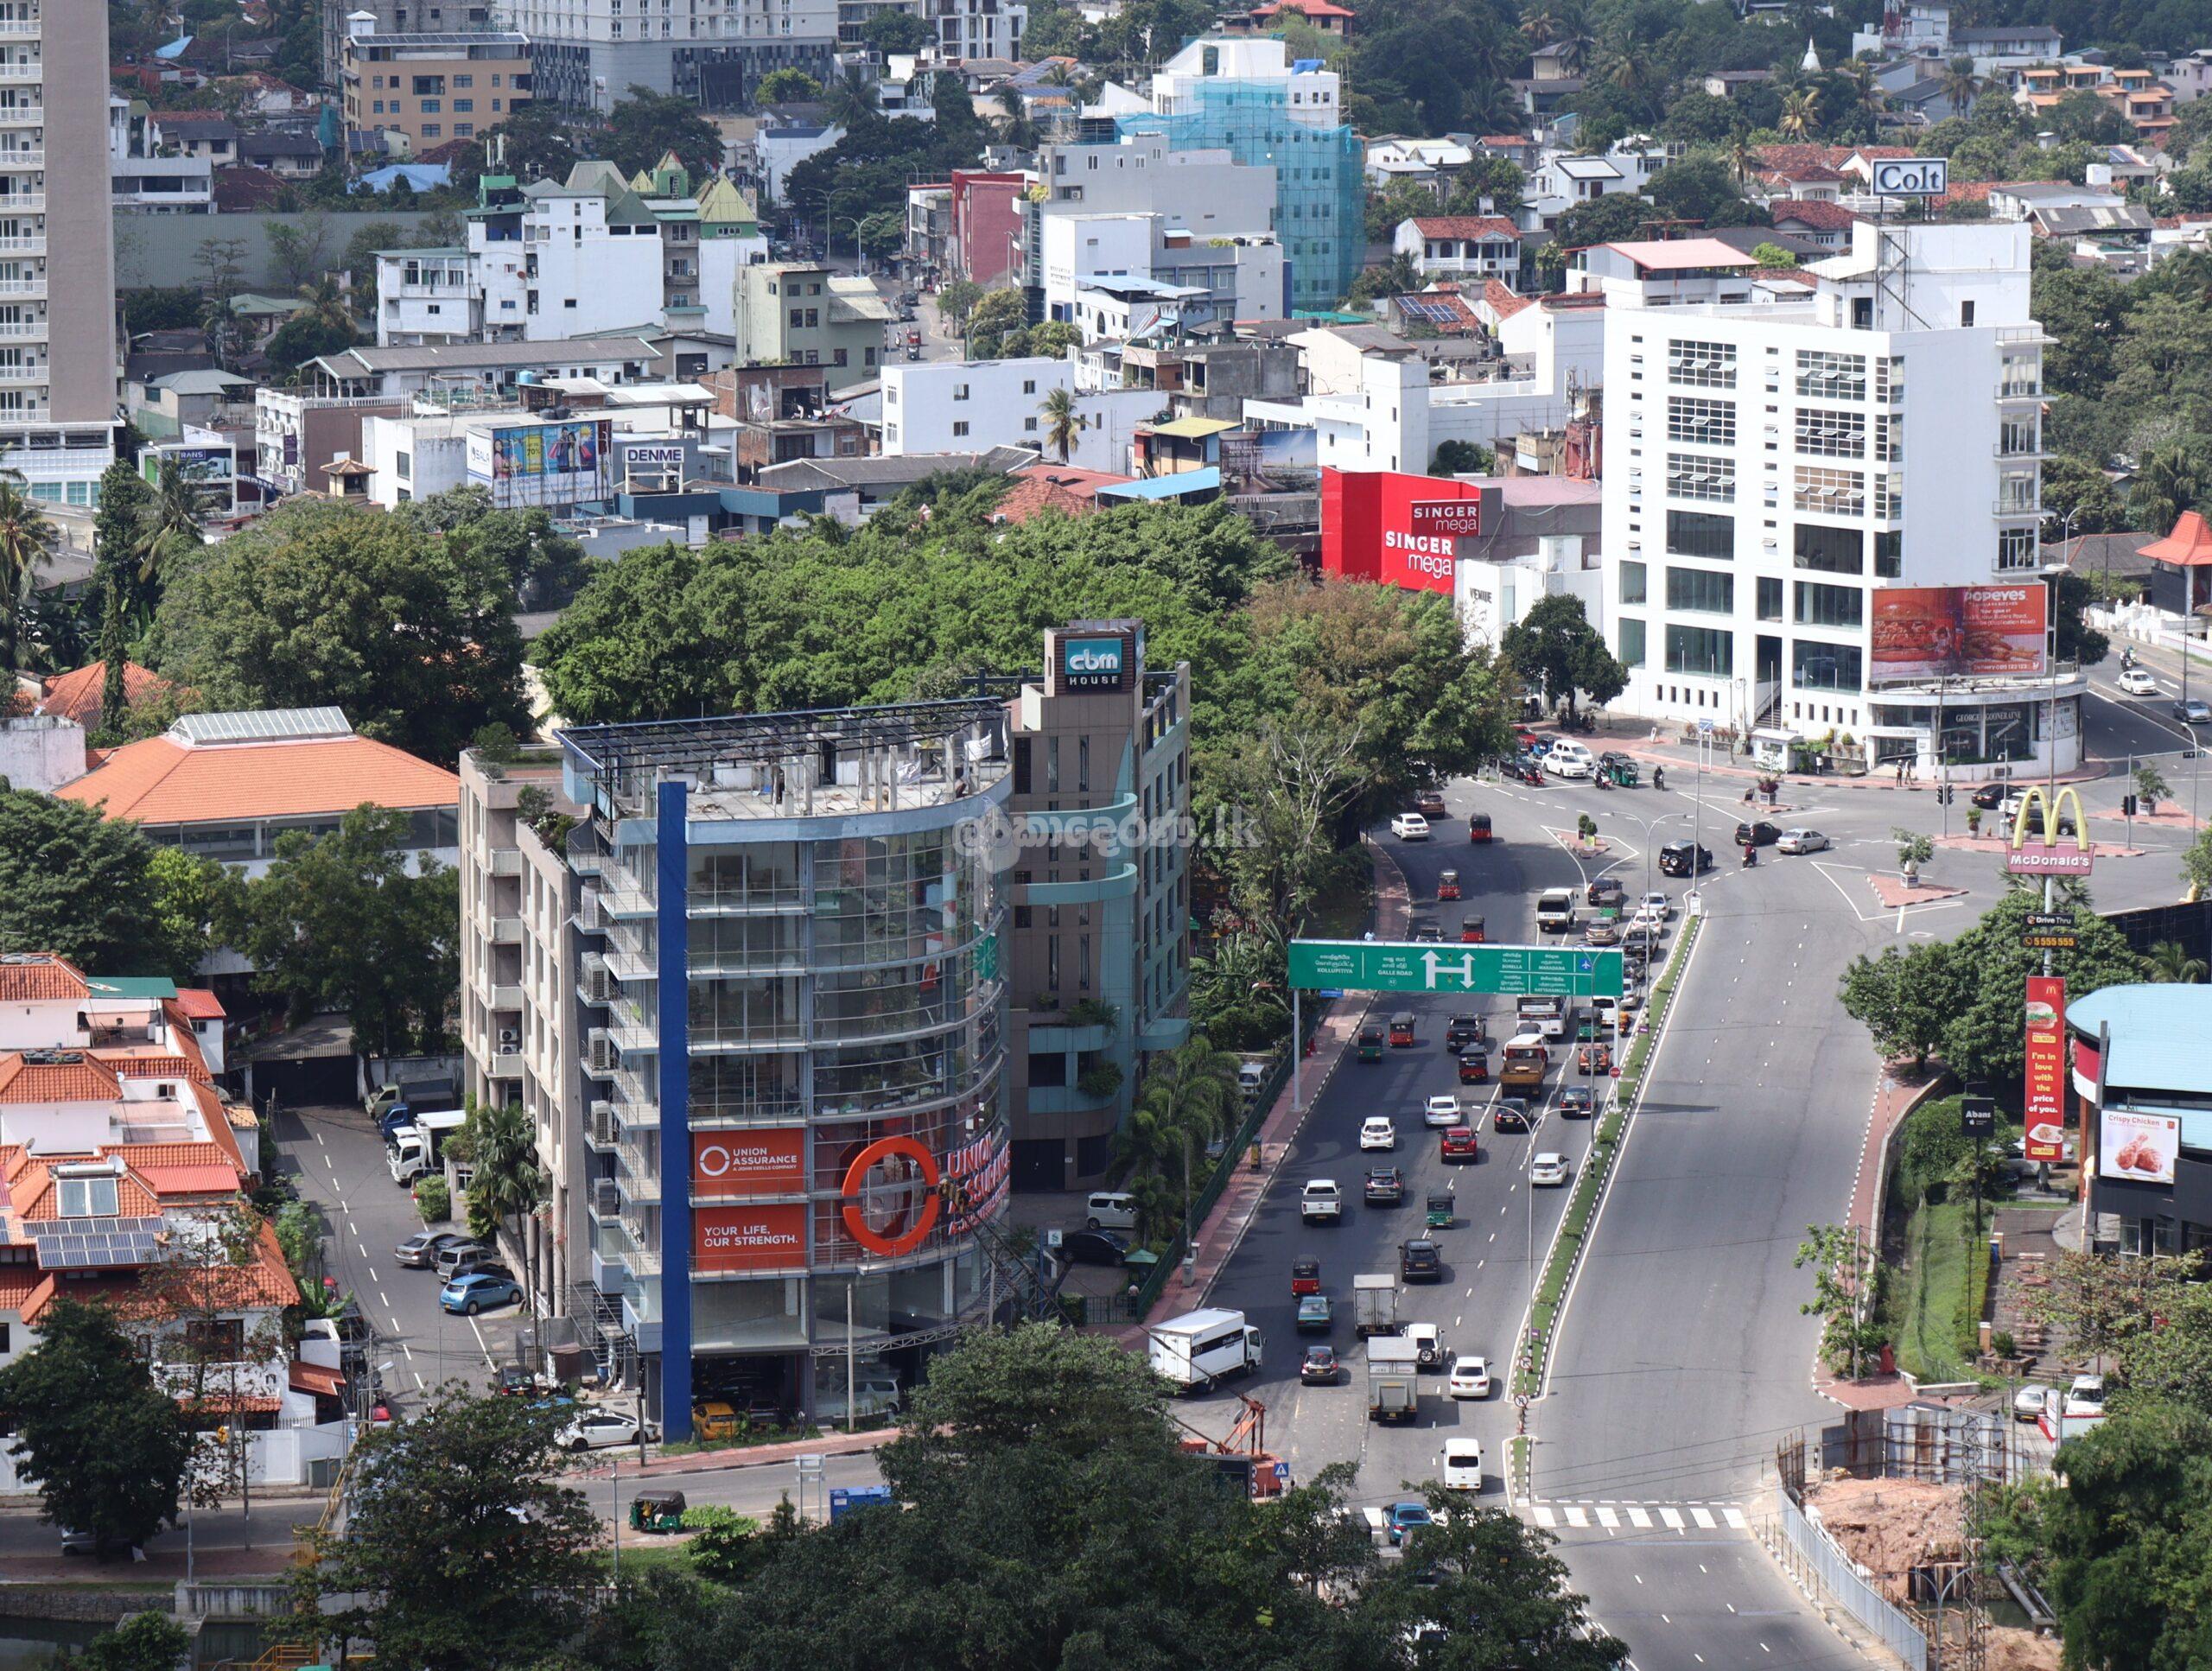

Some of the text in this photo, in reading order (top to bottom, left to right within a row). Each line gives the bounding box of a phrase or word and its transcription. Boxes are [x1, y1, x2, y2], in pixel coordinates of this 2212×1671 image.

[1879, 165, 1939, 190] Colt
[627, 449, 682, 461] DENME
[1414, 506, 1477, 518] SINGER
[1435, 518, 1477, 533] mega
[1385, 531, 1452, 556] SINGER
[1408, 554, 1452, 579] mega
[1070, 649, 1117, 670] cbm
[1069, 676, 1118, 685] HOUSE
[1955, 714, 1980, 722] GEORGE
[2011, 855, 2089, 867] McDonald's
[2034, 937, 2074, 946] 5 555 555
[2037, 1083, 2050, 1092] the
[2033, 1094, 2054, 1103] price
[2039, 1106, 2058, 1115] you.
[2108, 1115, 2130, 1126] Crispy
[2131, 1117, 2160, 1127] Chicken
[733, 1147, 767, 1156] UNION
[733, 1155, 797, 1166] ASSURANCE
[704, 1225, 771, 1236] YOUR LIFE,
[704, 1235, 798, 1247] OUR STRENGTH.
